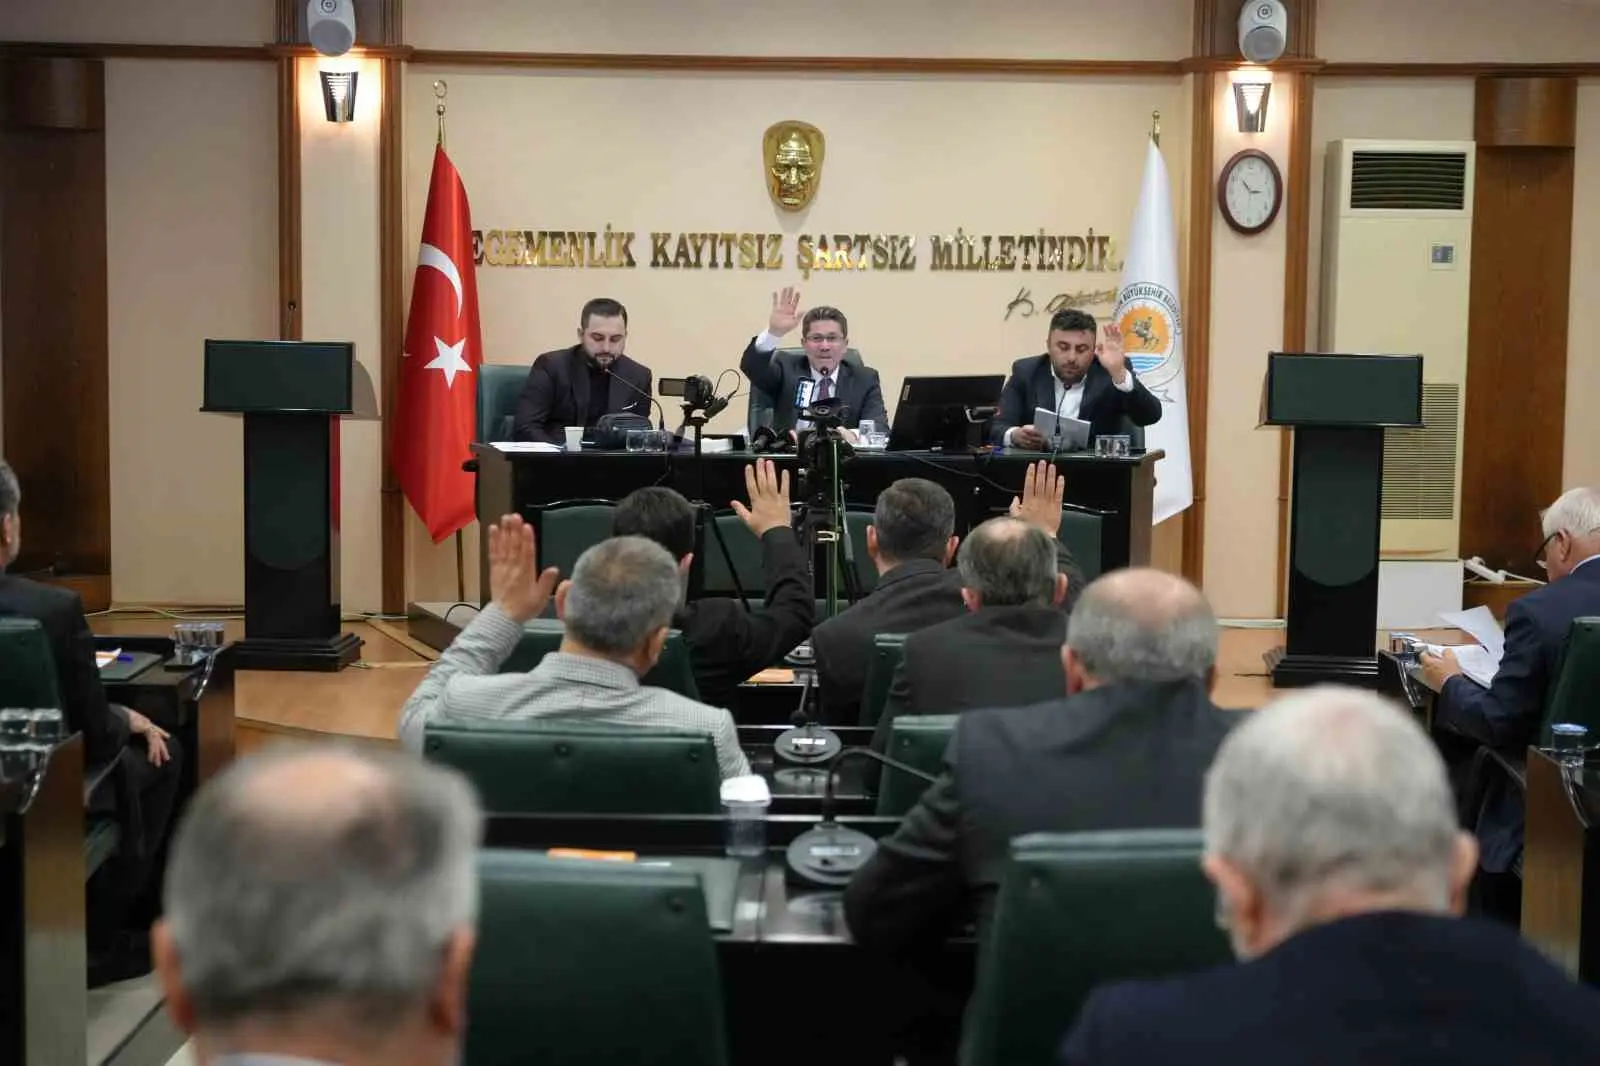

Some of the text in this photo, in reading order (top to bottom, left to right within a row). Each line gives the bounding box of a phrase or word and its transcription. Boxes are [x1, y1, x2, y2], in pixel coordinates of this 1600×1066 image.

[472, 224, 636, 268] EGEMENLİK
[650, 232, 783, 269] KAYITSIZ
[797, 233, 917, 280] ŞARTSIZ
